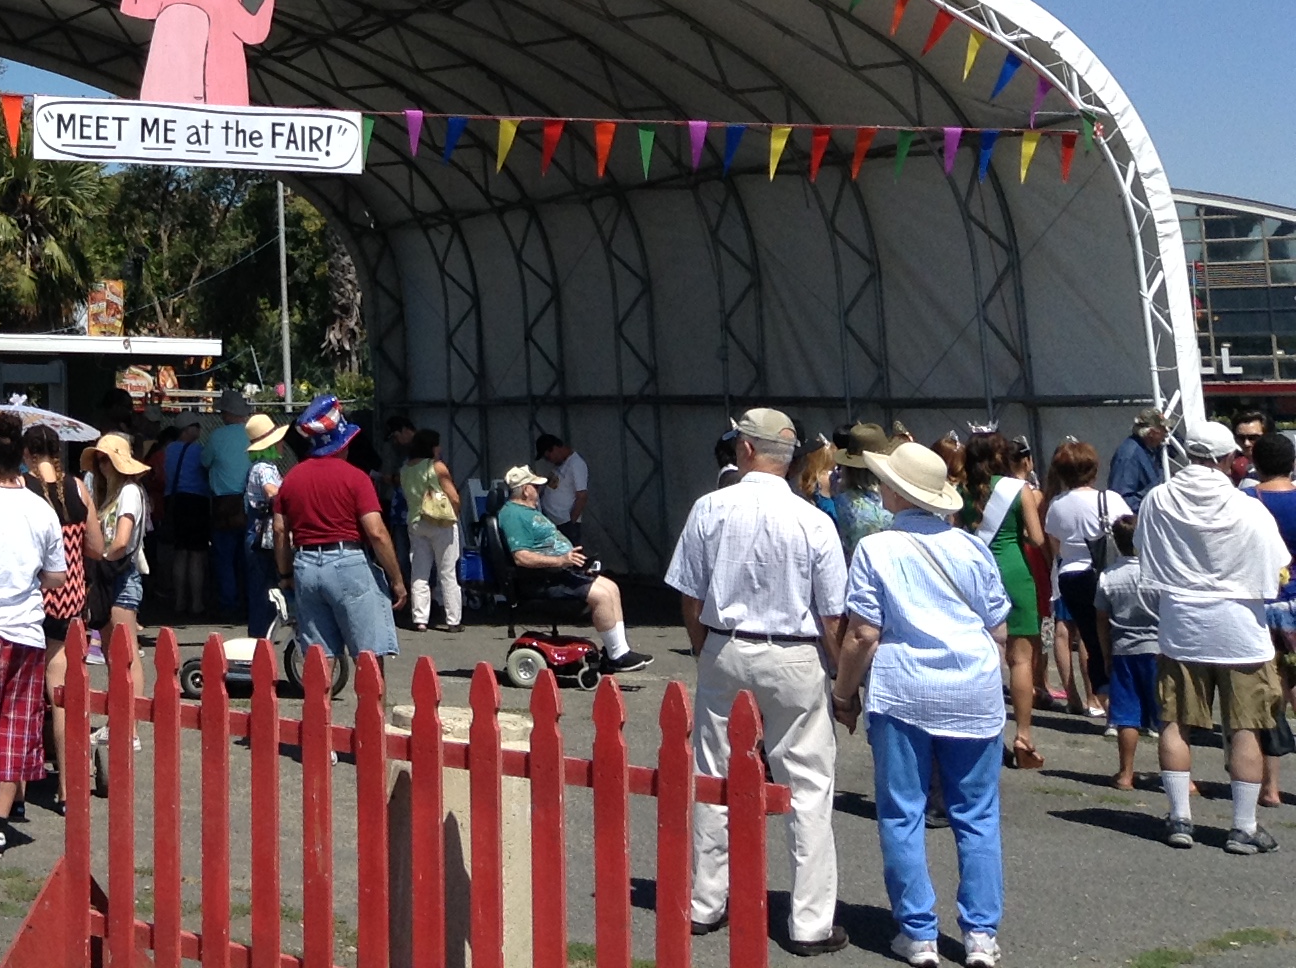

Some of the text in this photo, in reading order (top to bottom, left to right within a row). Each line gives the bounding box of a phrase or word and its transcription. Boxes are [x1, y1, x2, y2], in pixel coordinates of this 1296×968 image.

[141, 117, 176, 144] ME
[186, 119, 213, 145] at
[222, 120, 263, 148] the
